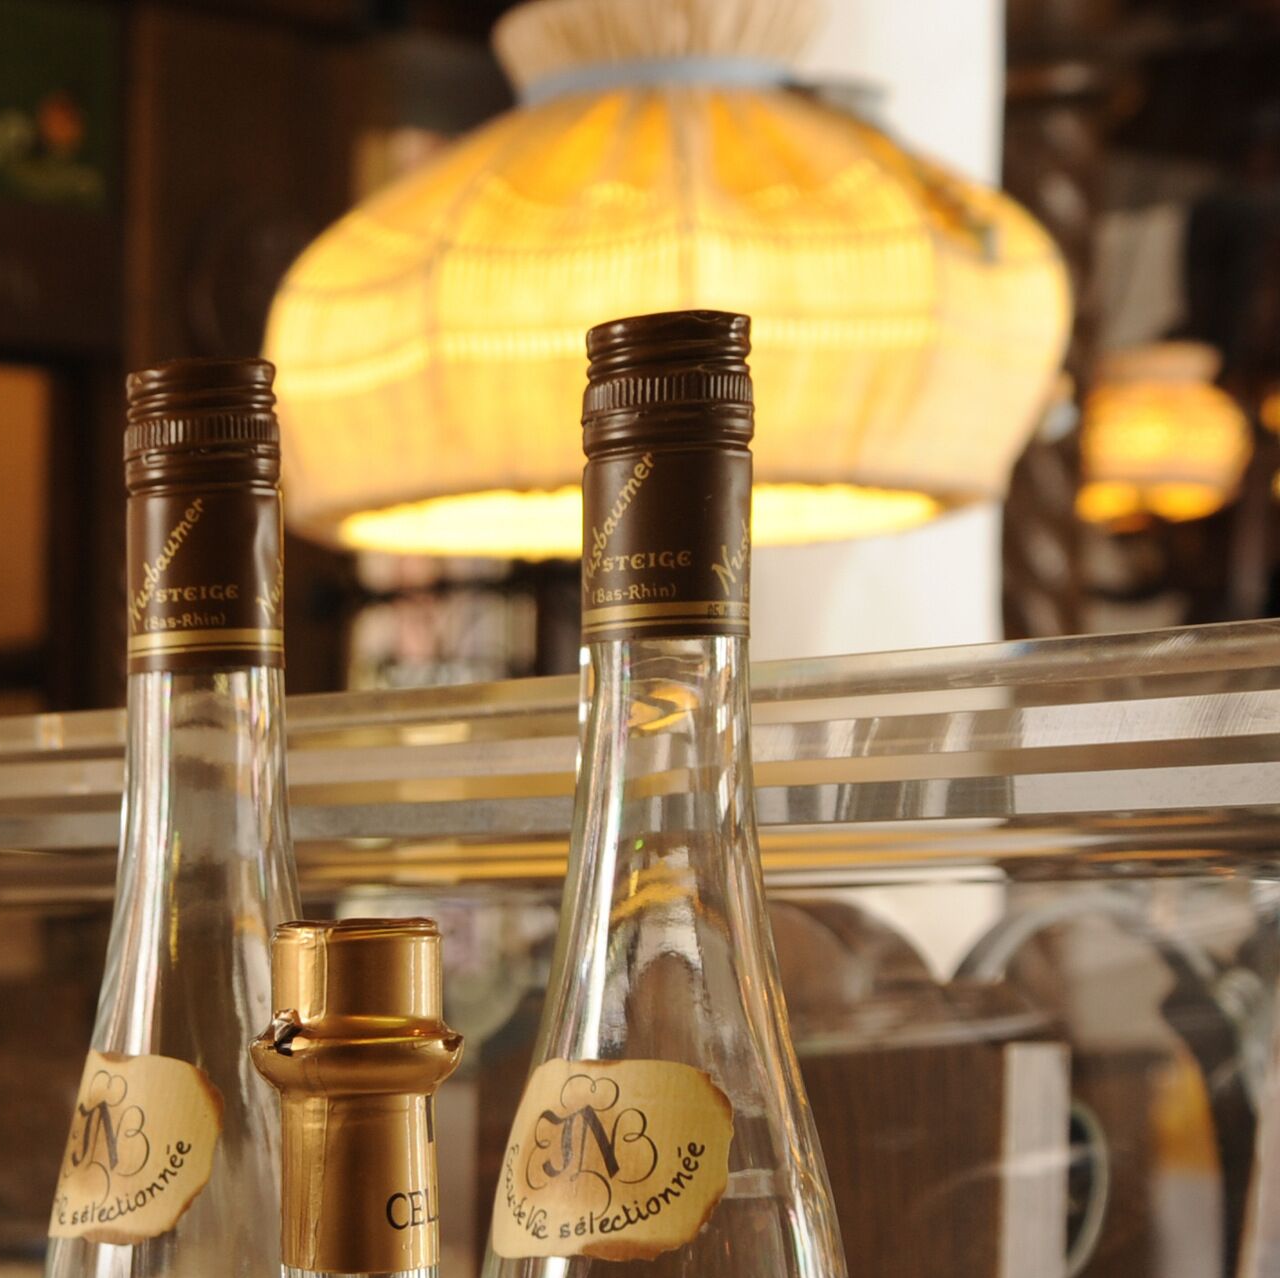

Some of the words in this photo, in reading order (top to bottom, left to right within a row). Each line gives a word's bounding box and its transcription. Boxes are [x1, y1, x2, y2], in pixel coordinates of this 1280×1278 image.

[602, 551, 691, 572] STEIGE
[155, 584, 239, 604] STEIGE
[592, 584, 677, 605] (Bas-Rhin)
[559, 1141, 705, 1239] sélectionnée
